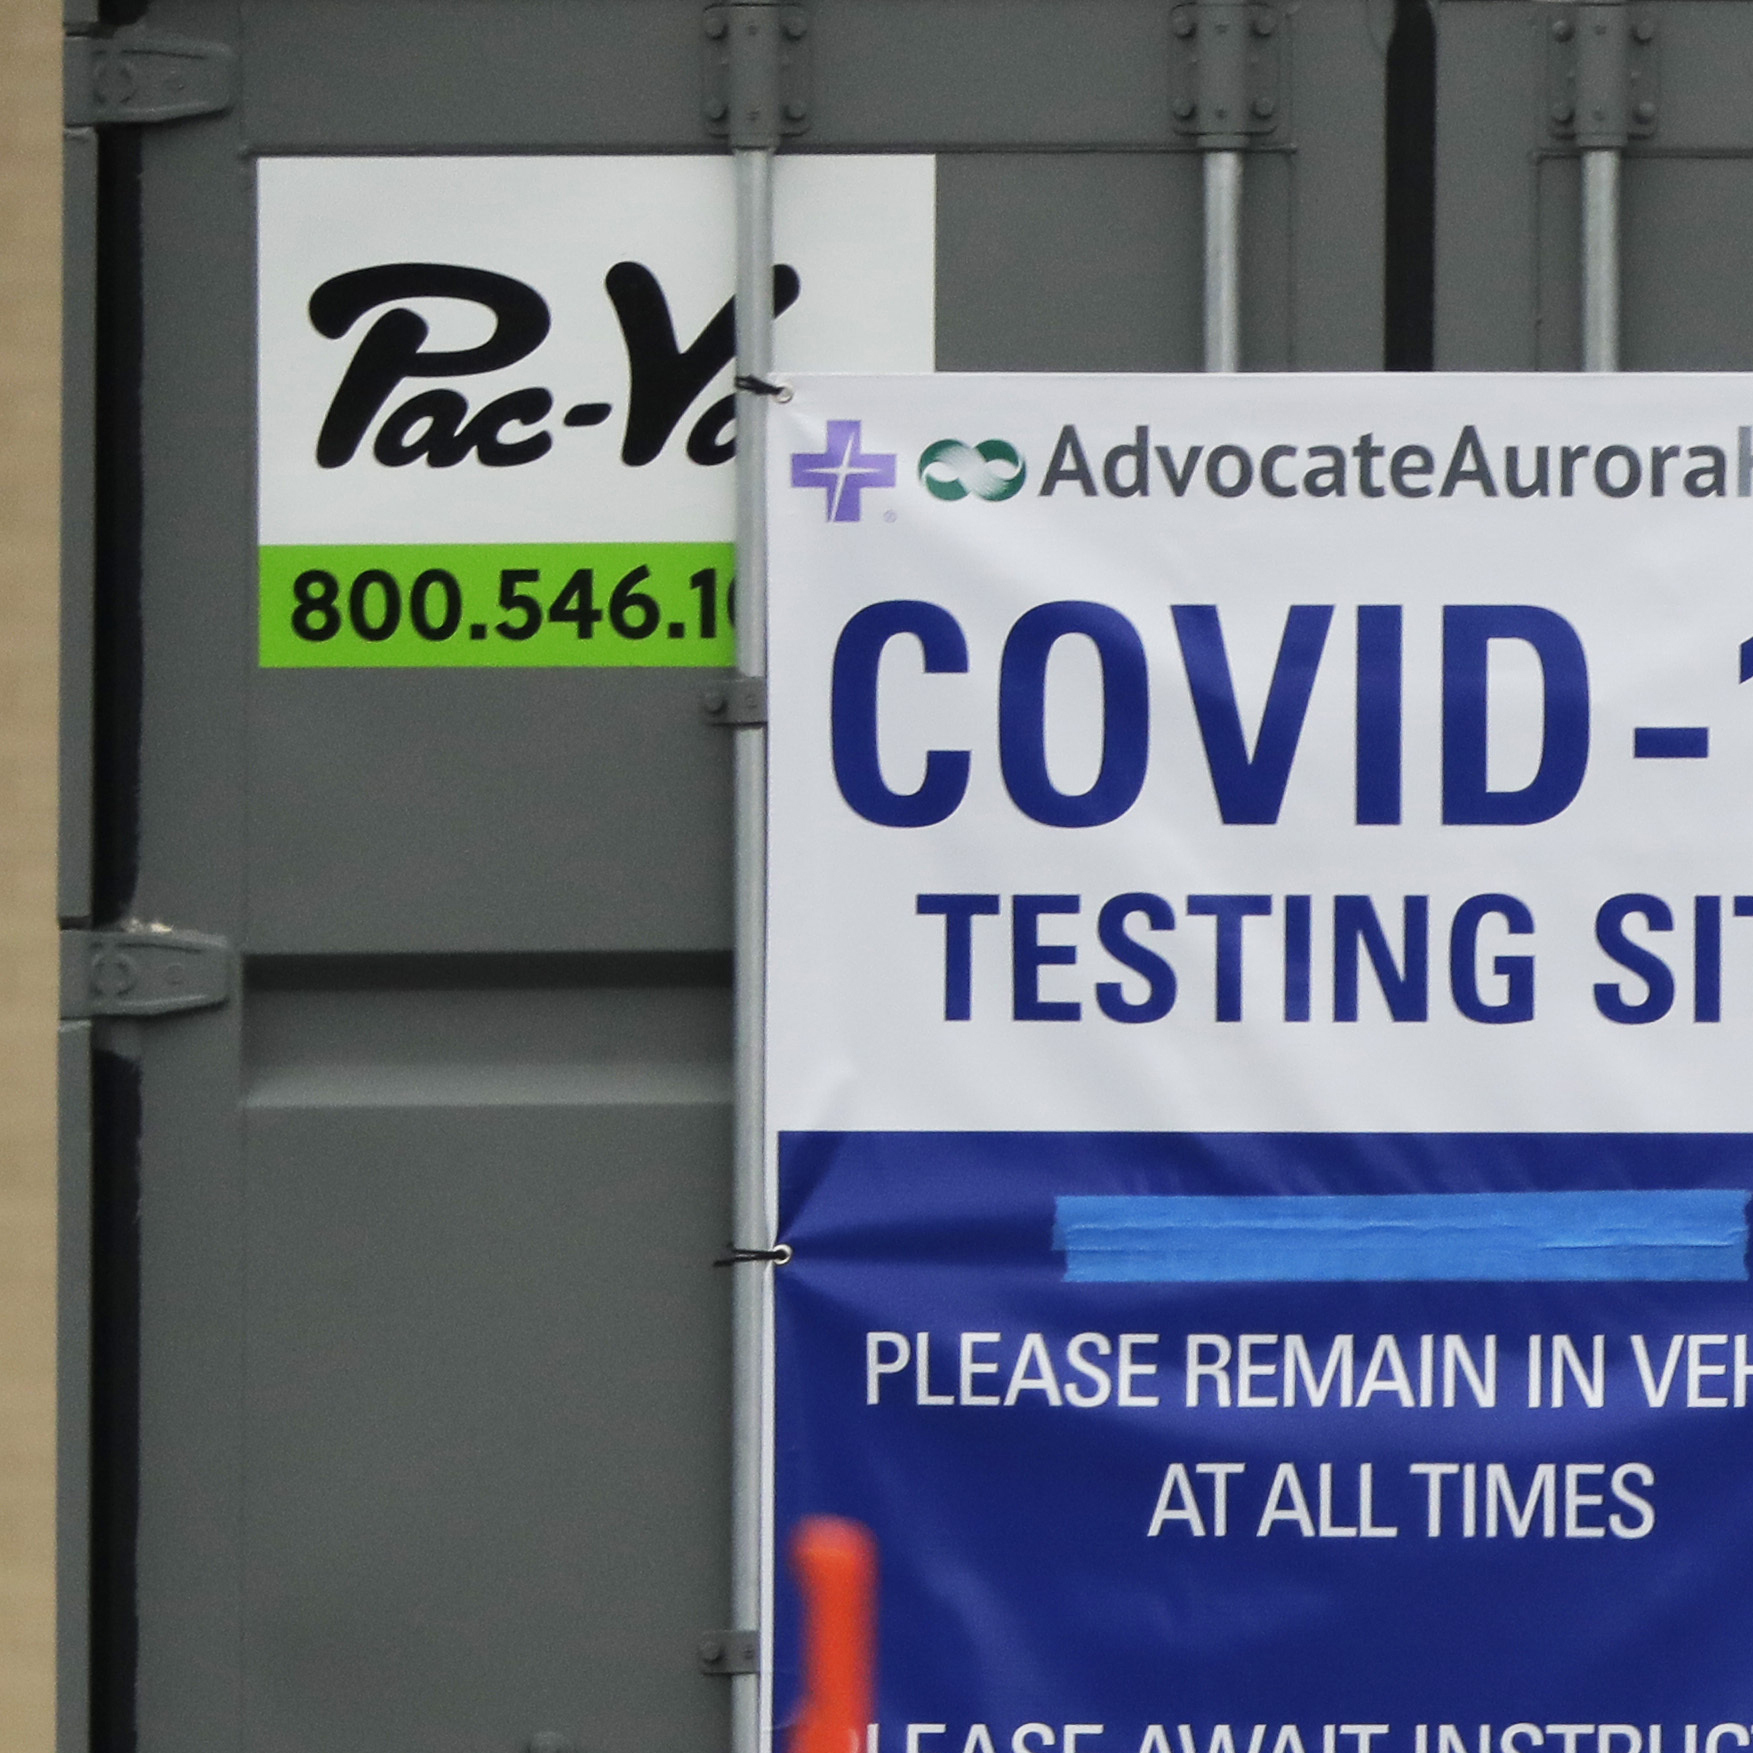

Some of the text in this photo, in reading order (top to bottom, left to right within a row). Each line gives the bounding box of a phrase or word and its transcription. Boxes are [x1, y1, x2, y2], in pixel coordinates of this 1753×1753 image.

[292, 565, 736, 641] 800.546.1
[916, 892, 1535, 1025] TESTING
[865, 1331, 1160, 1408] PLEASE
[1184, 1333, 1498, 1409] REMAIN
[1527, 1333, 1606, 1409] IN
[1147, 1462, 1656, 1539] AT ALL TIMES
